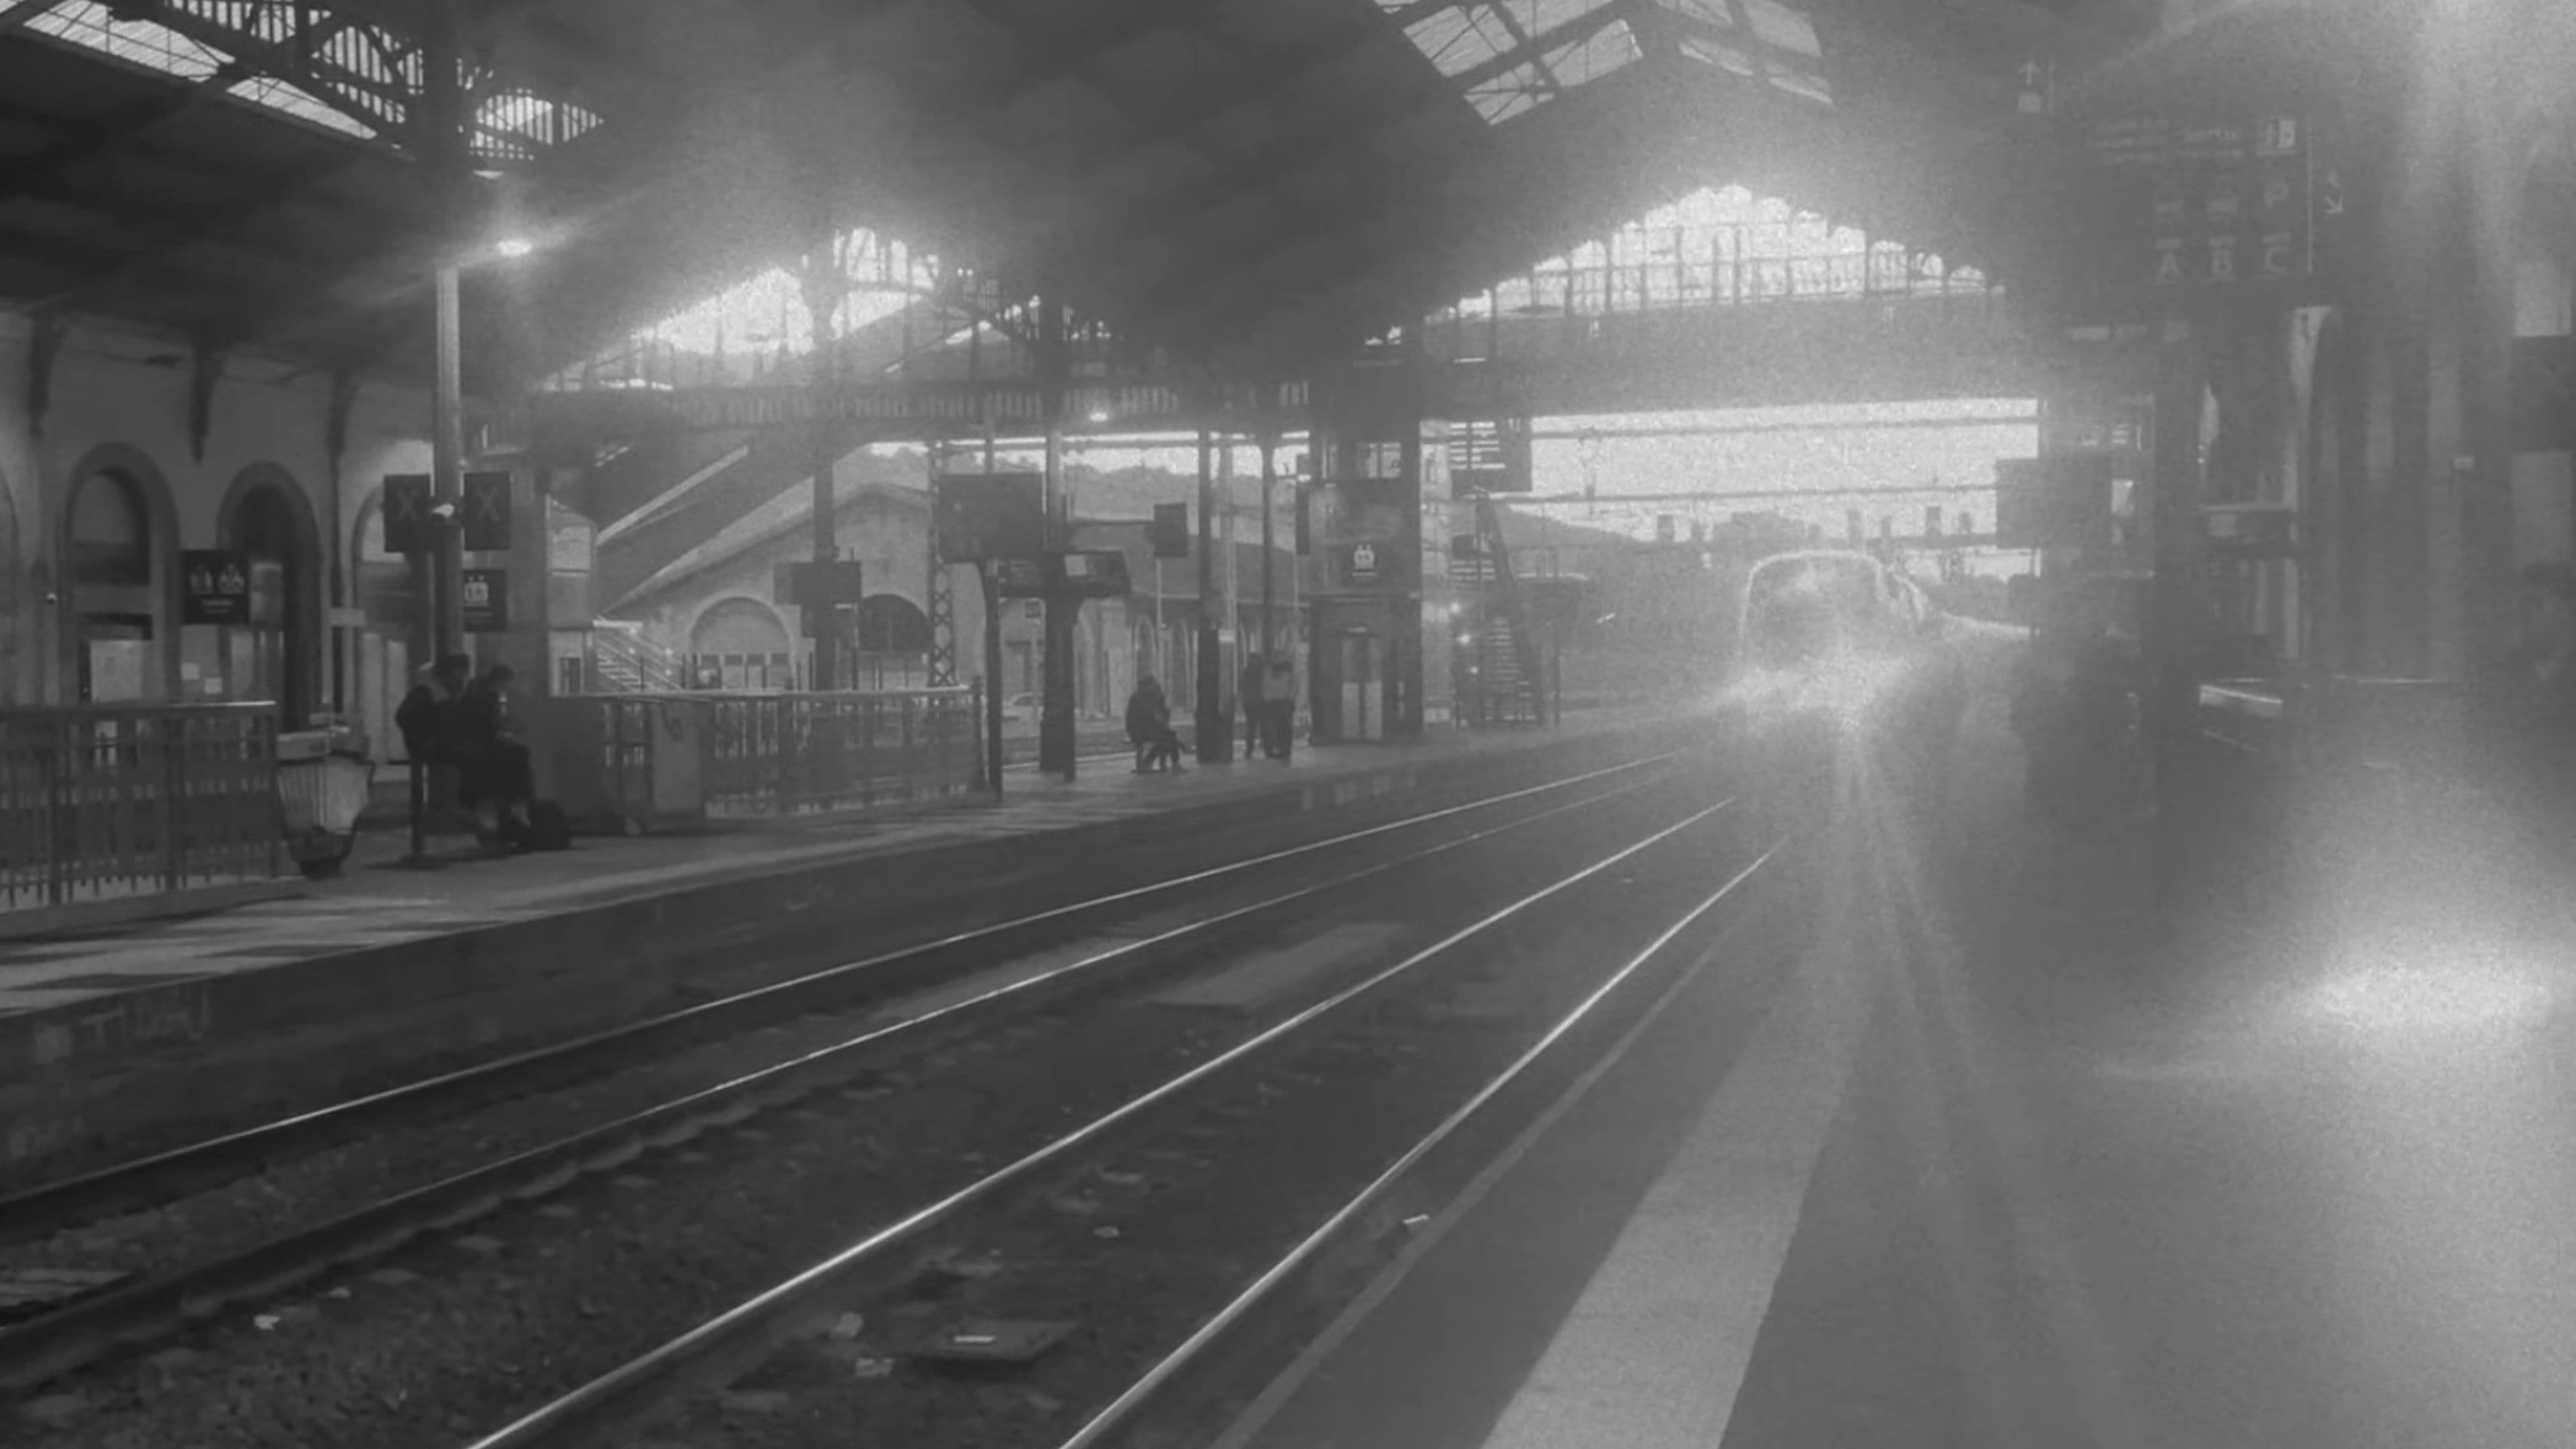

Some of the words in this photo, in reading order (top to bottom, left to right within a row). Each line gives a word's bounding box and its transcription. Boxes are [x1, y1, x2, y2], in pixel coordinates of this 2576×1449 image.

[2155, 251, 2182, 281] A
[2211, 248, 2233, 276] B
[2264, 245, 2290, 273] C
